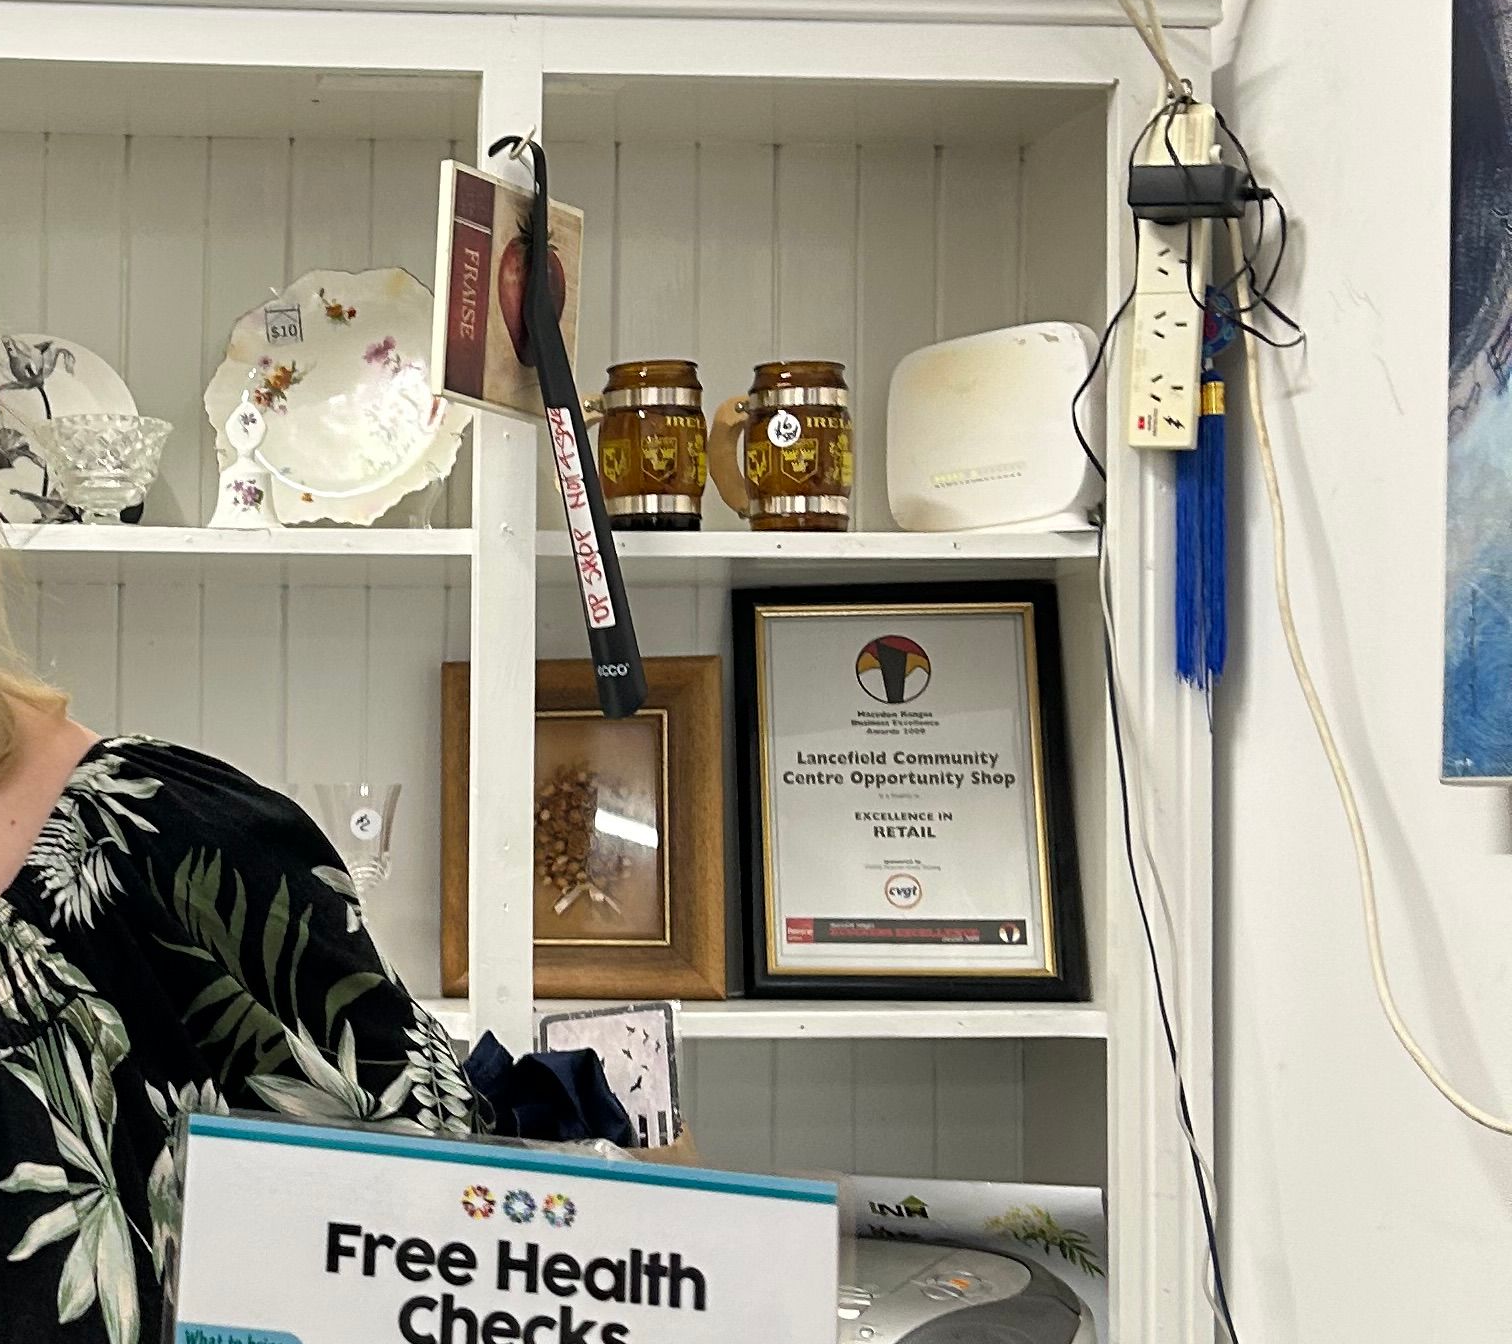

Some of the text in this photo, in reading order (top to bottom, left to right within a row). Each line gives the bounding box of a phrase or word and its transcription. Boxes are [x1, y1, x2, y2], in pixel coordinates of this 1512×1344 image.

[460, 247, 480, 340] PRAISE
[271, 324, 298, 338] $10
[562, 472, 586, 510] NOT
[587, 593, 609, 624] OP
[797, 751, 998, 768] Lancefield Community
[782, 771, 1016, 789] Centre Opportunity Shop
[854, 811, 953, 822] EXCELLENCE IN
[873, 826, 937, 839] RETAIL
[889, 885, 917, 898] cvgt
[325, 1221, 707, 1311] Free Health
